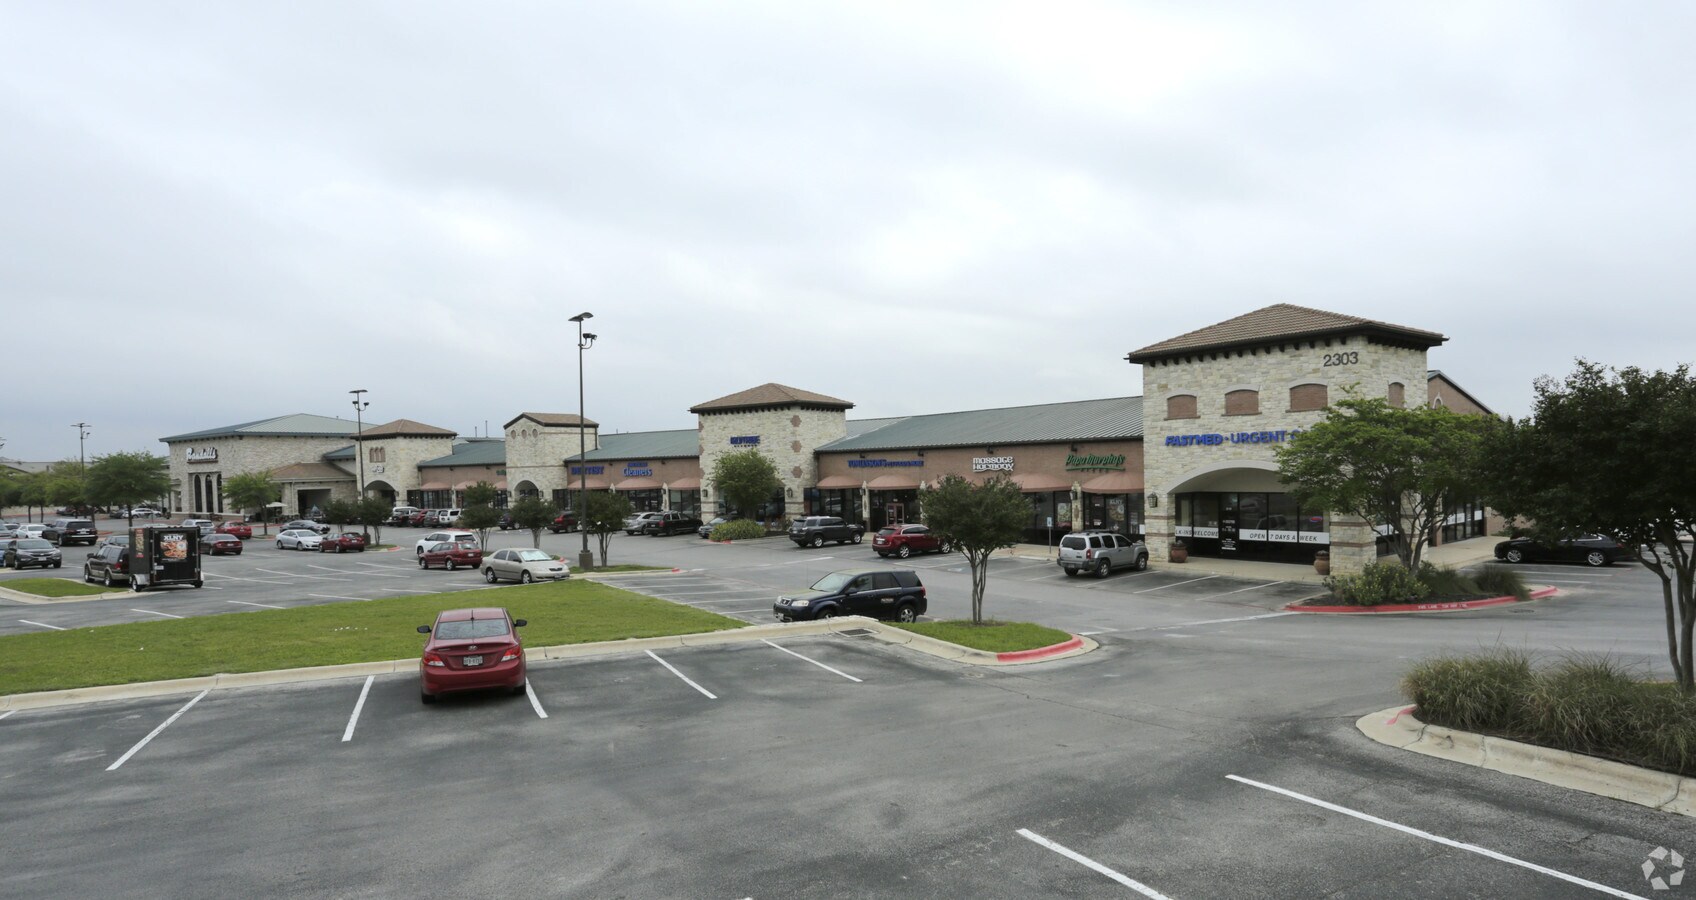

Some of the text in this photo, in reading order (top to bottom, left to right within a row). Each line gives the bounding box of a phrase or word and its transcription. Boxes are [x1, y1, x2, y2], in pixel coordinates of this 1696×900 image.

[1323, 351, 1359, 367] 2303
[1165, 433, 1223, 446] FASTMED
[1230, 430, 1287, 444] URGENT
[623, 467, 653, 477] Cleaners
